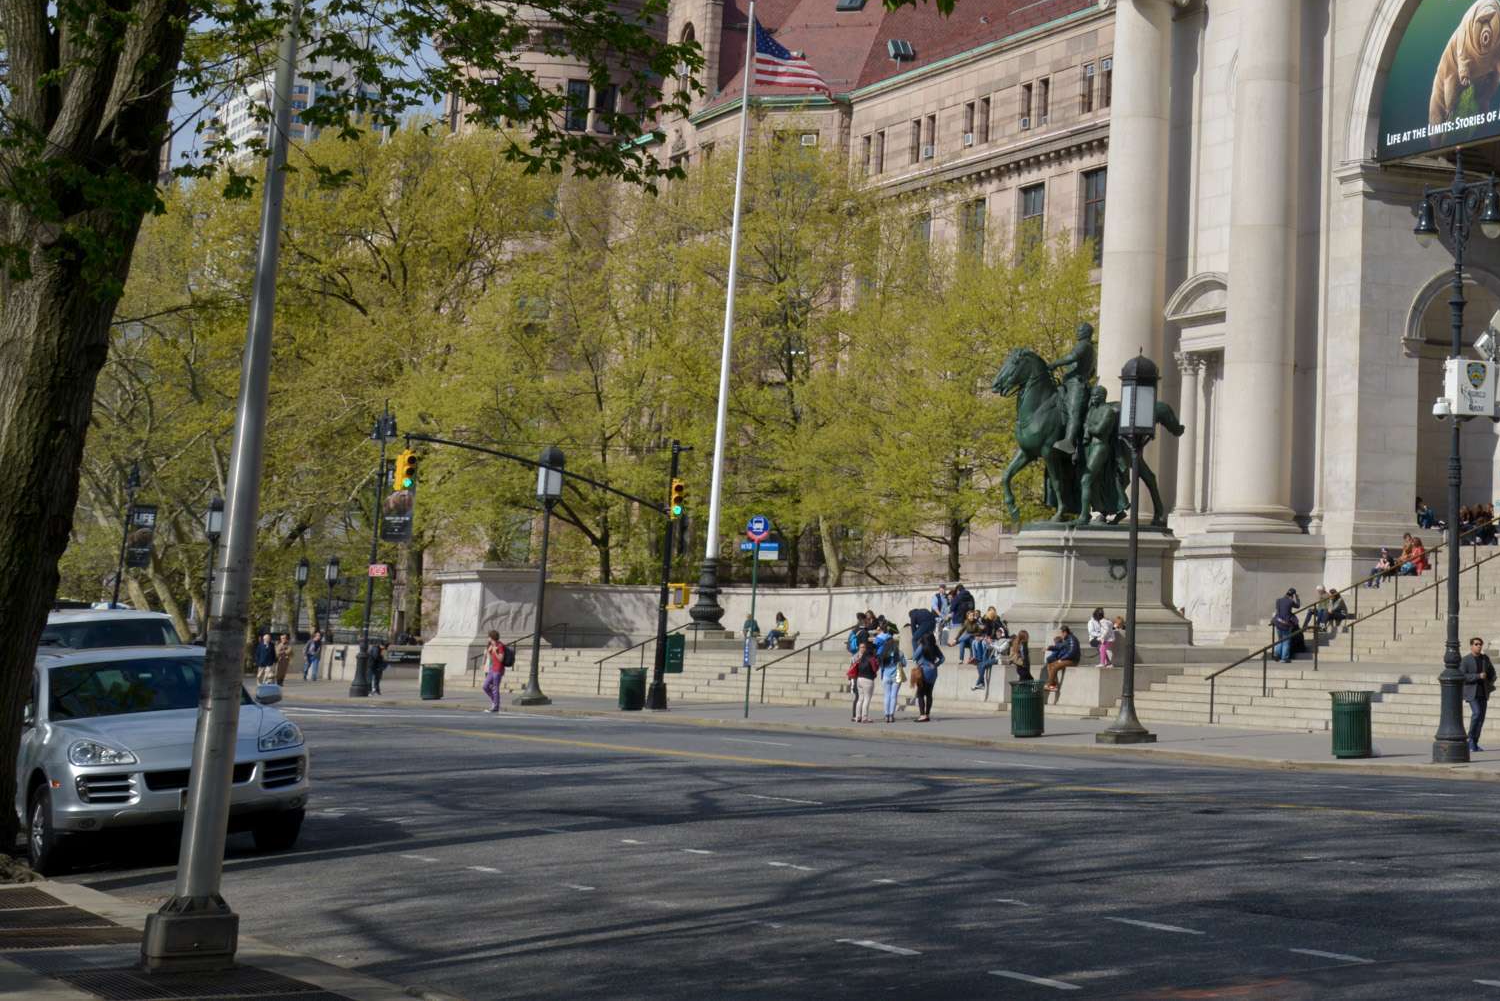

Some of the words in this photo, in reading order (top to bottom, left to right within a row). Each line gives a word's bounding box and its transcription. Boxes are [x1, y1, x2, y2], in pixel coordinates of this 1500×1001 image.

[1387, 132, 1401, 146] LIFE
[1402, 131, 1411, 142] AT
[1412, 127, 1427, 141] THE
[1427, 121, 1455, 137] LIMITS:
[1455, 114, 1486, 130] STORIES
[1486, 111, 1497, 123] OF
